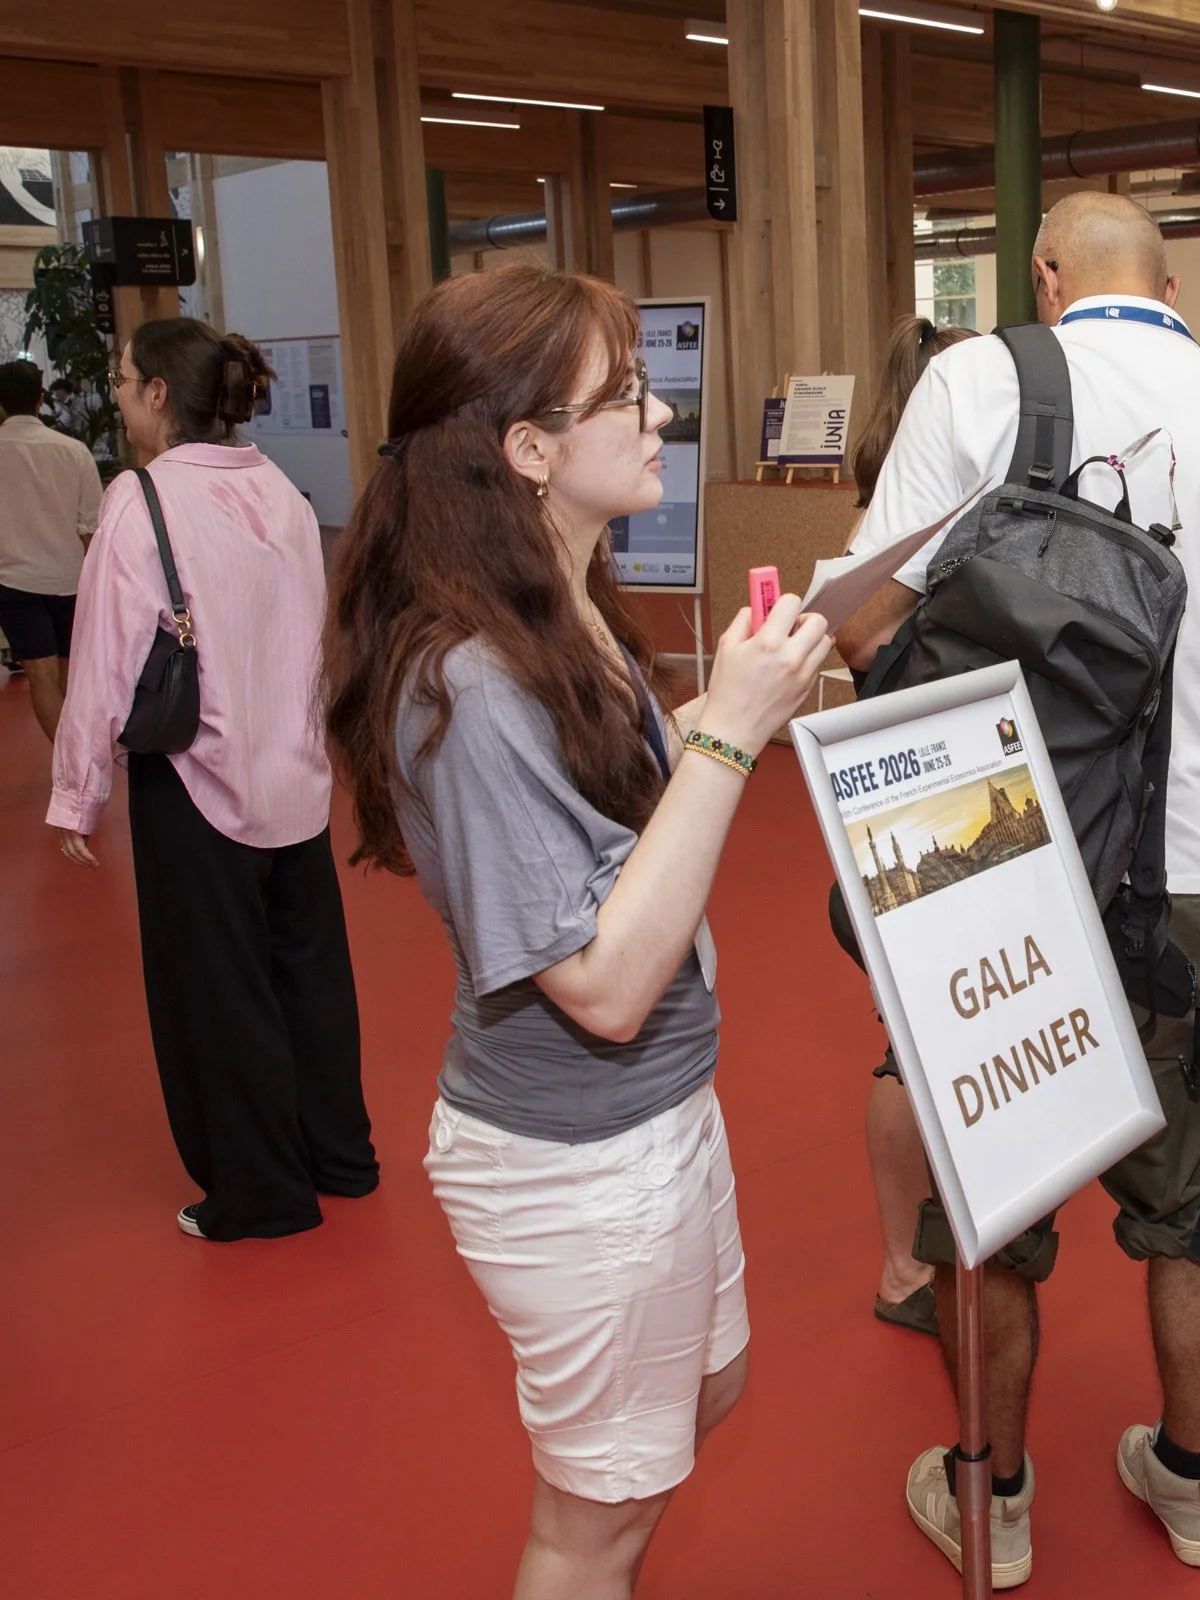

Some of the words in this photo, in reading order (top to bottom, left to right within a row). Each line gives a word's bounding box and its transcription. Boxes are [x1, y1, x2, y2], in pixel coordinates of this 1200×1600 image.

[645, 339, 657, 348] JUNE
[677, 341, 698, 349] ASFEE
[930, 740, 947, 754] FRANCE
[1003, 741, 1022, 755] ASFEE
[922, 758, 936, 773] JUNE
[936, 754, 952, 770] 25-26
[829, 761, 880, 802] ASFEE
[879, 748, 921, 786] 2026
[852, 799, 883, 815] Conference
[884, 797, 890, 805] of
[890, 794, 900, 803] the
[900, 787, 918, 800] French
[918, 777, 950, 792] Experimental
[950, 768, 977, 783] Economics
[976, 760, 1002, 774] Association
[949, 934, 1053, 1019] GALA
[951, 1007, 1101, 1129] DINNER
